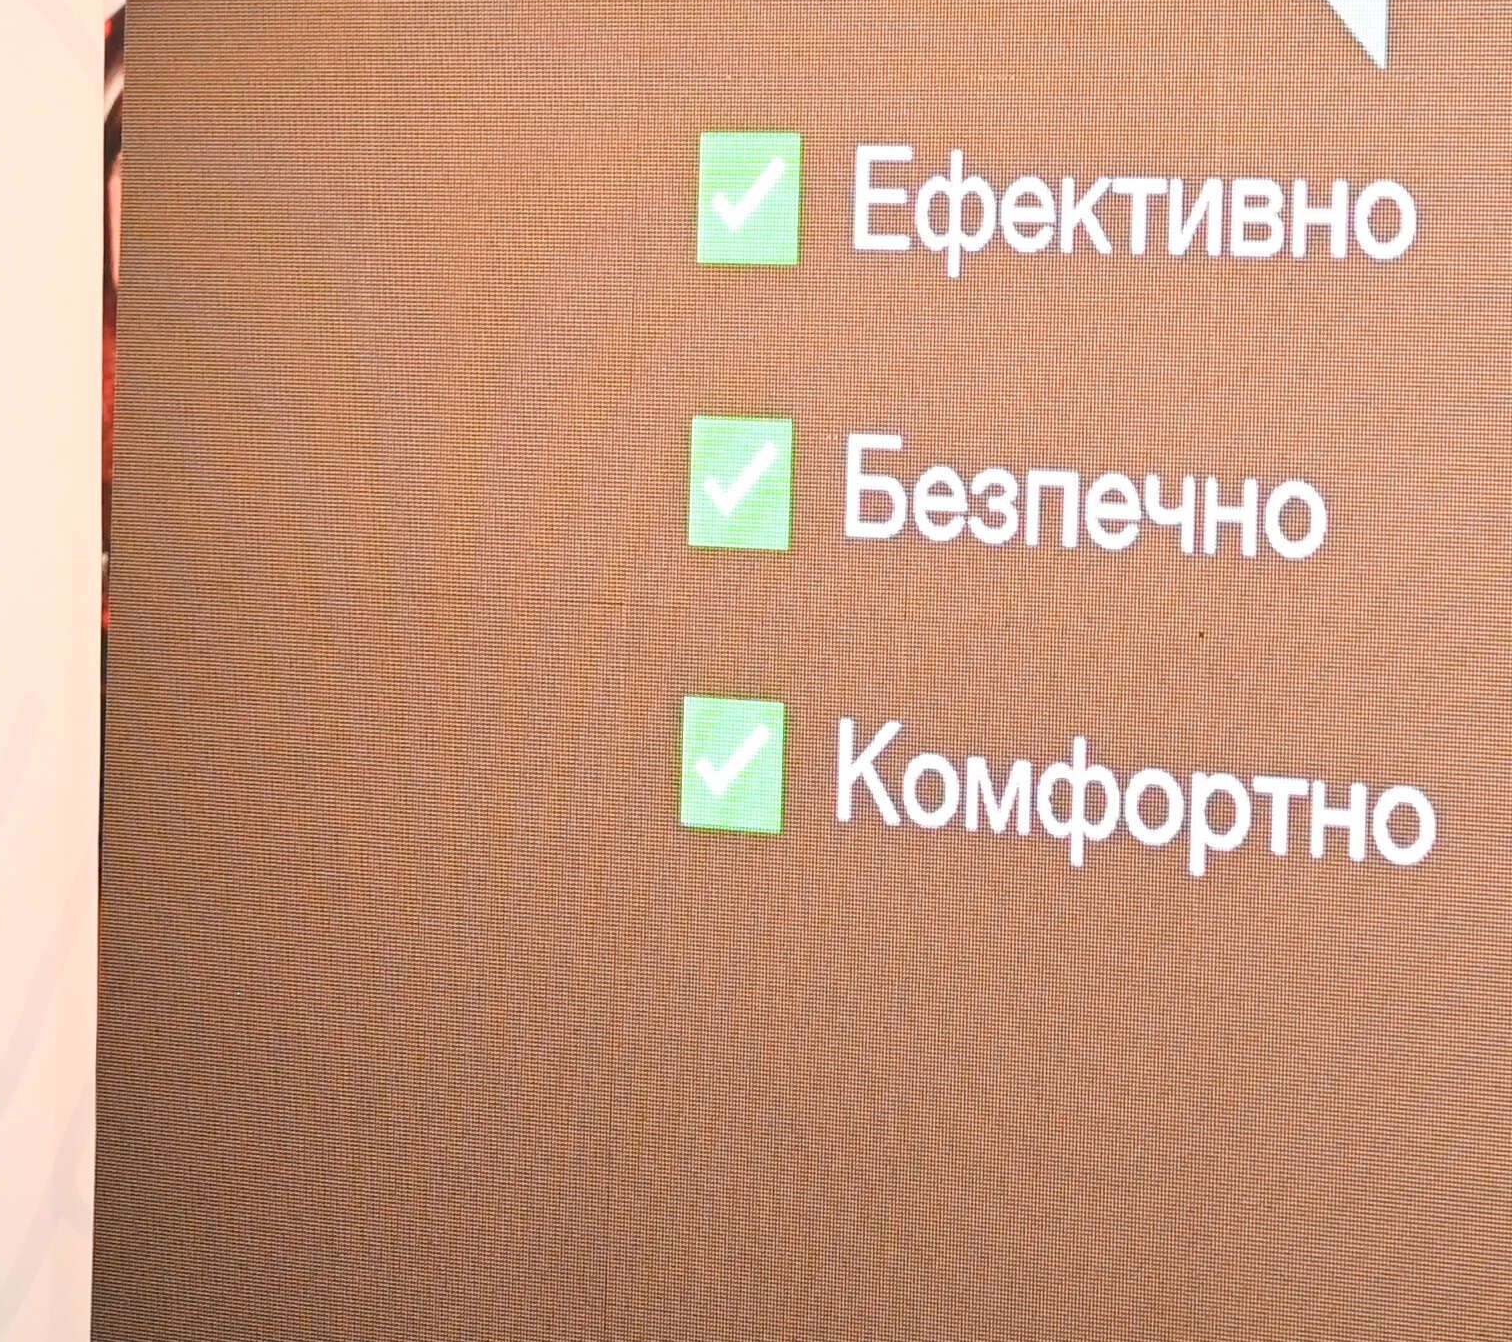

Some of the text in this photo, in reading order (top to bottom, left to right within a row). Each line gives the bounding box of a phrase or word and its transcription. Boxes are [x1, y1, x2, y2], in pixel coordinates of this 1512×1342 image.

[853, 144, 1417, 278] Ефективно
[844, 432, 1327, 560] Безпечно
[836, 717, 1437, 878] Комфортно
